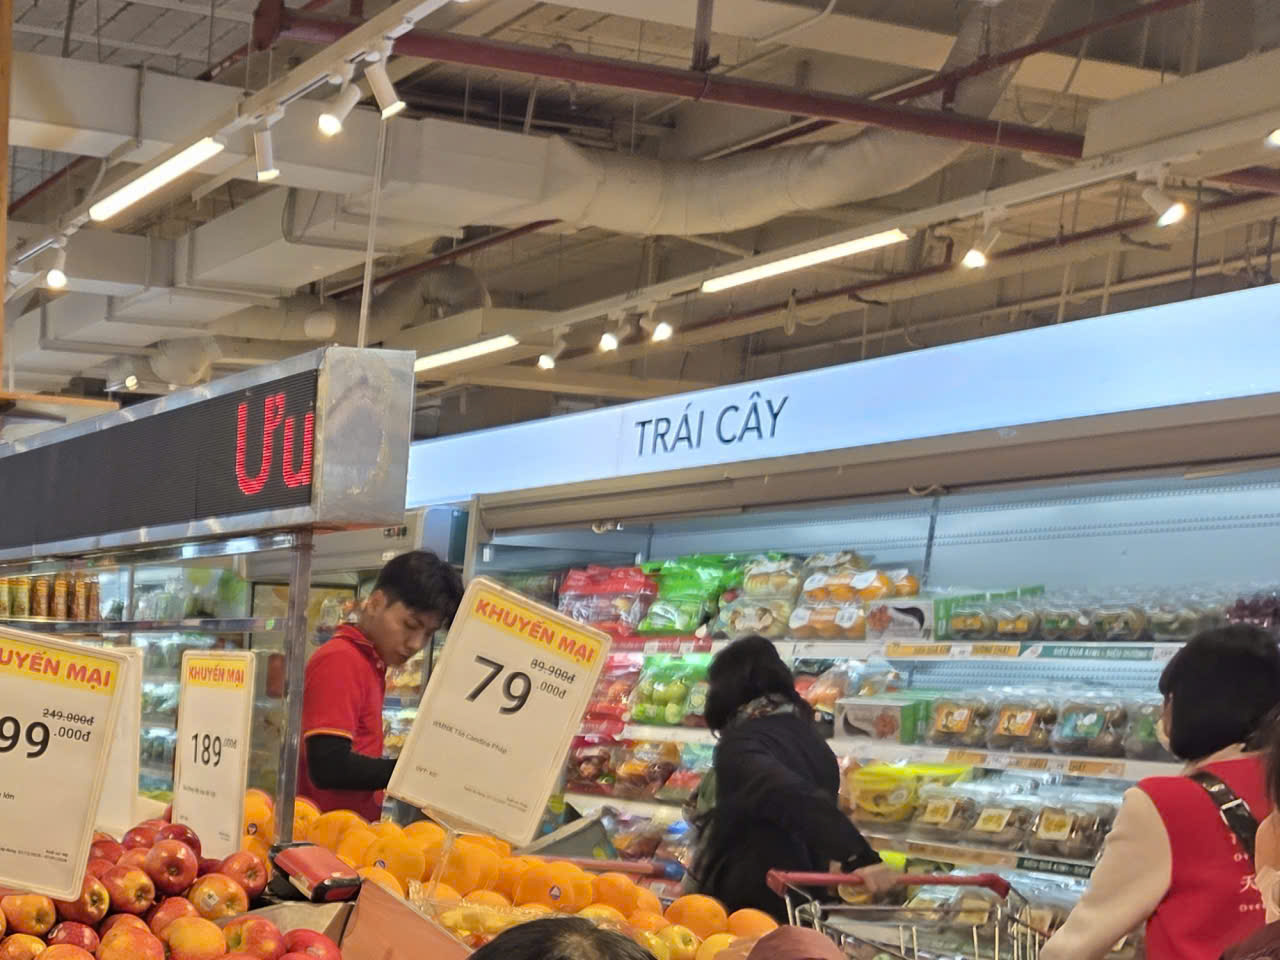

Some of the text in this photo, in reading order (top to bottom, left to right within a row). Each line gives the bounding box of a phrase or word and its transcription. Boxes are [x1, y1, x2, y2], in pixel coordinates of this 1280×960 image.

[635, 390, 789, 457] TRÁI CÂY
[235, 392, 314, 495] Ưu
[474, 598, 595, 663] KHUYẾN MẠI
[66, 663, 111, 689] MẠI
[188, 664, 244, 687] KHUYẾN MẠI
[465, 655, 532, 715] 79
[42, 708, 95, 726] 249.000đ
[53, 726, 92, 742] .000đ
[192, 732, 222, 768] 189
